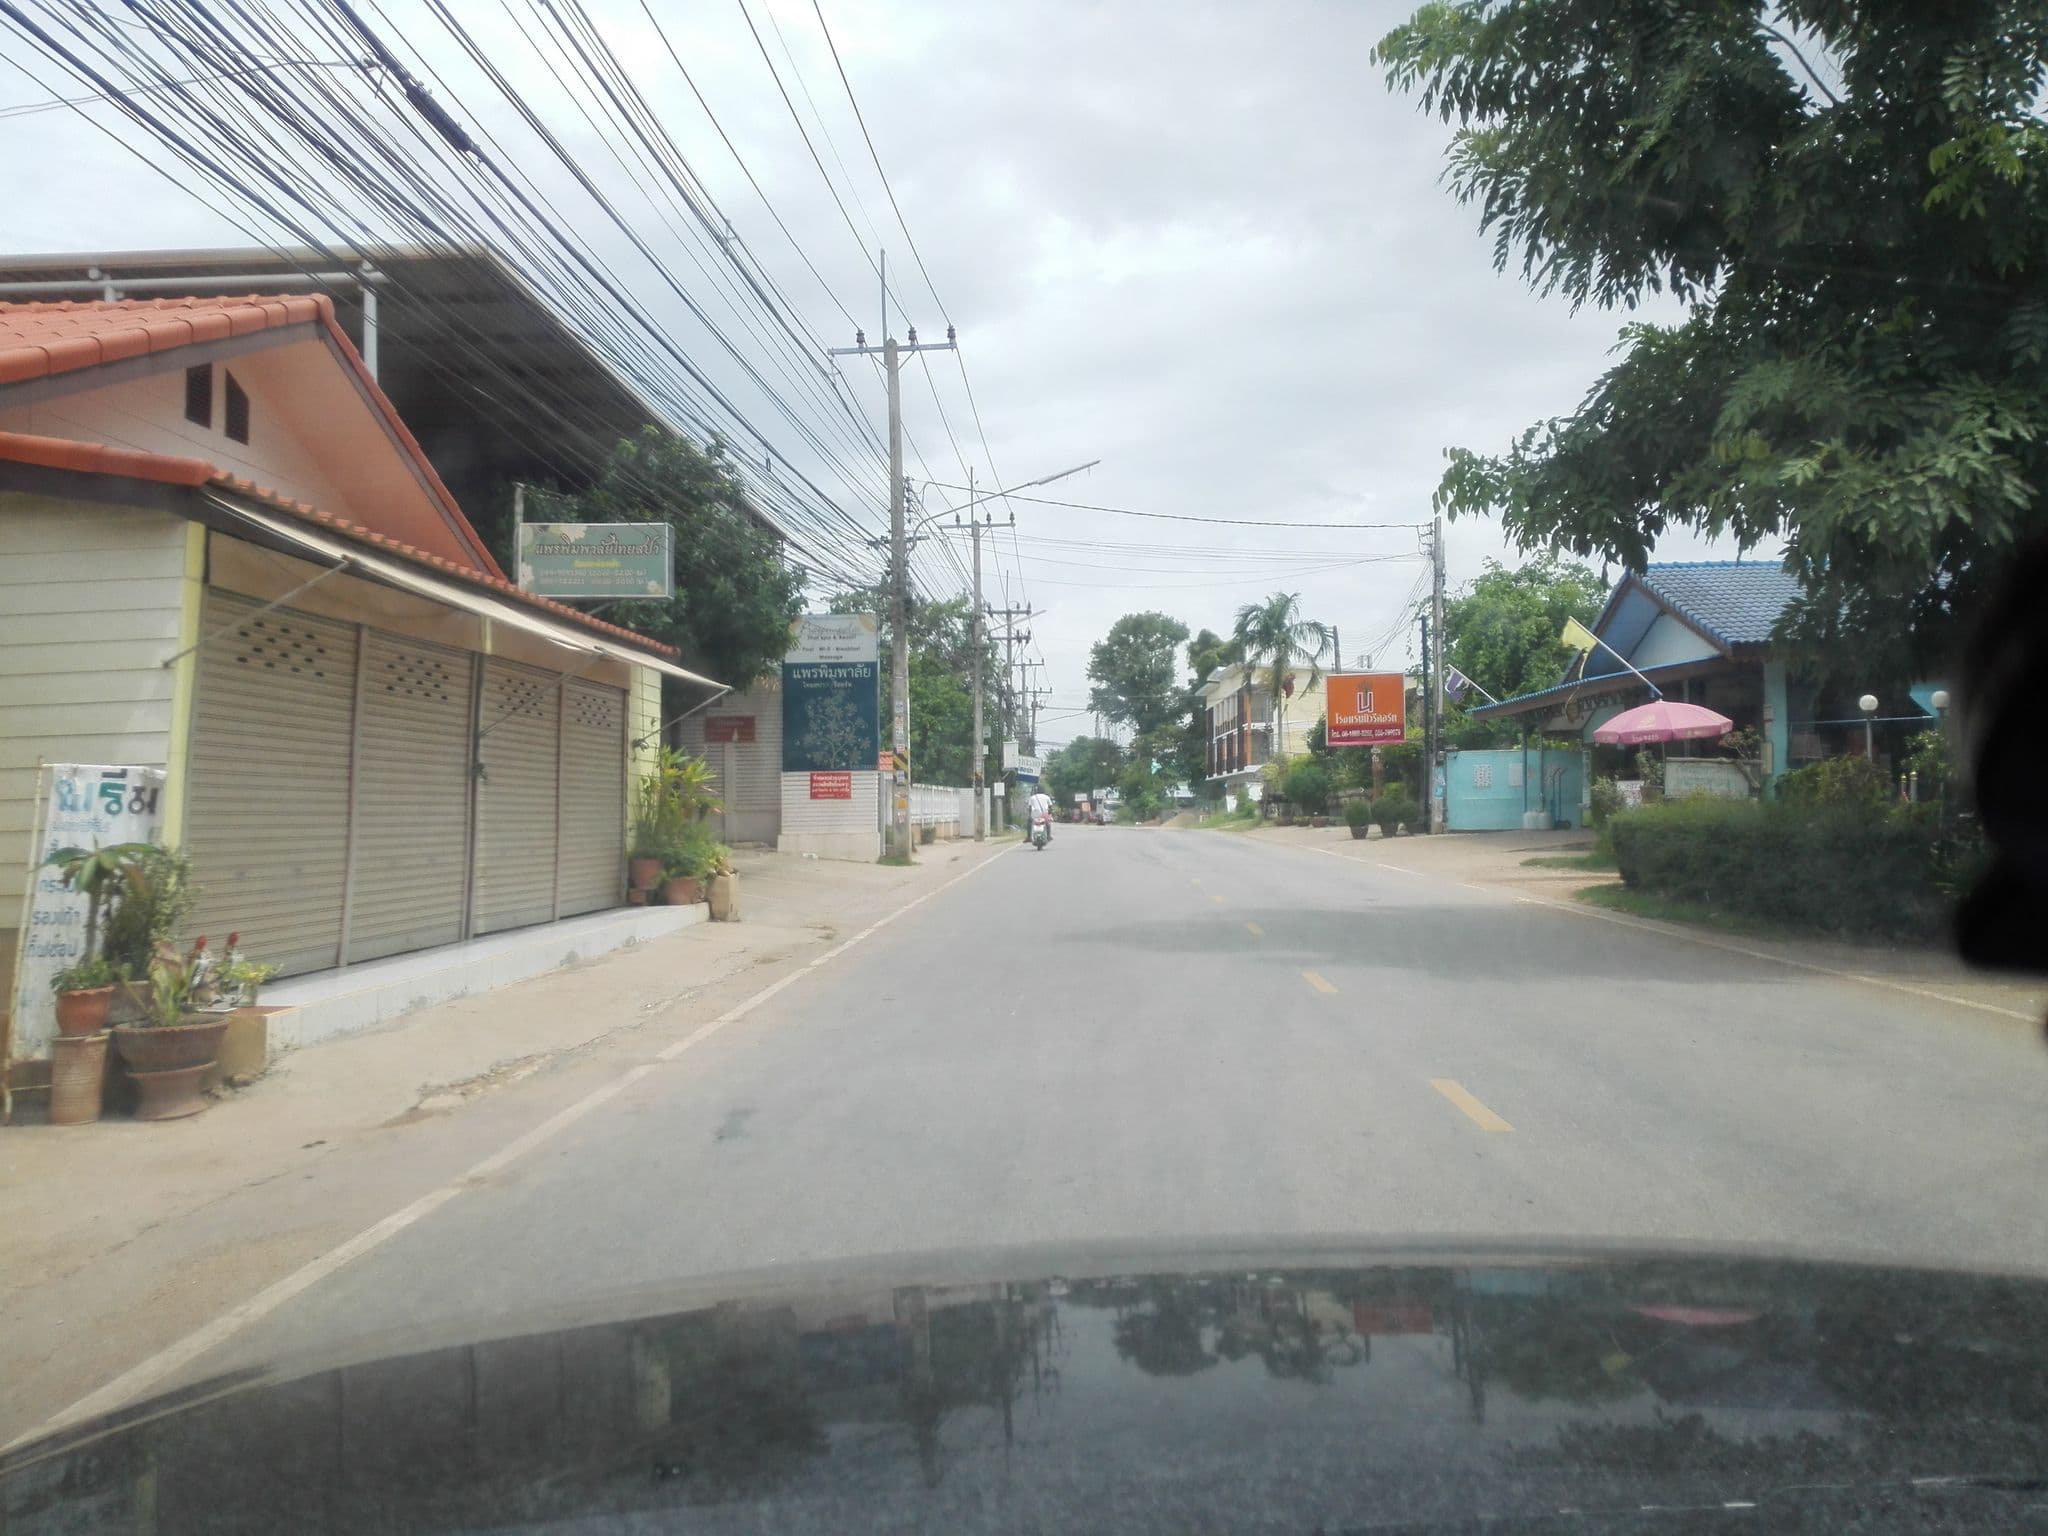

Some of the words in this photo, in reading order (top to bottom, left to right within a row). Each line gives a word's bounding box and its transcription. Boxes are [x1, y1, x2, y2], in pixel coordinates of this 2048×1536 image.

[792, 663, 872, 680] แพรพิมพาลัย
